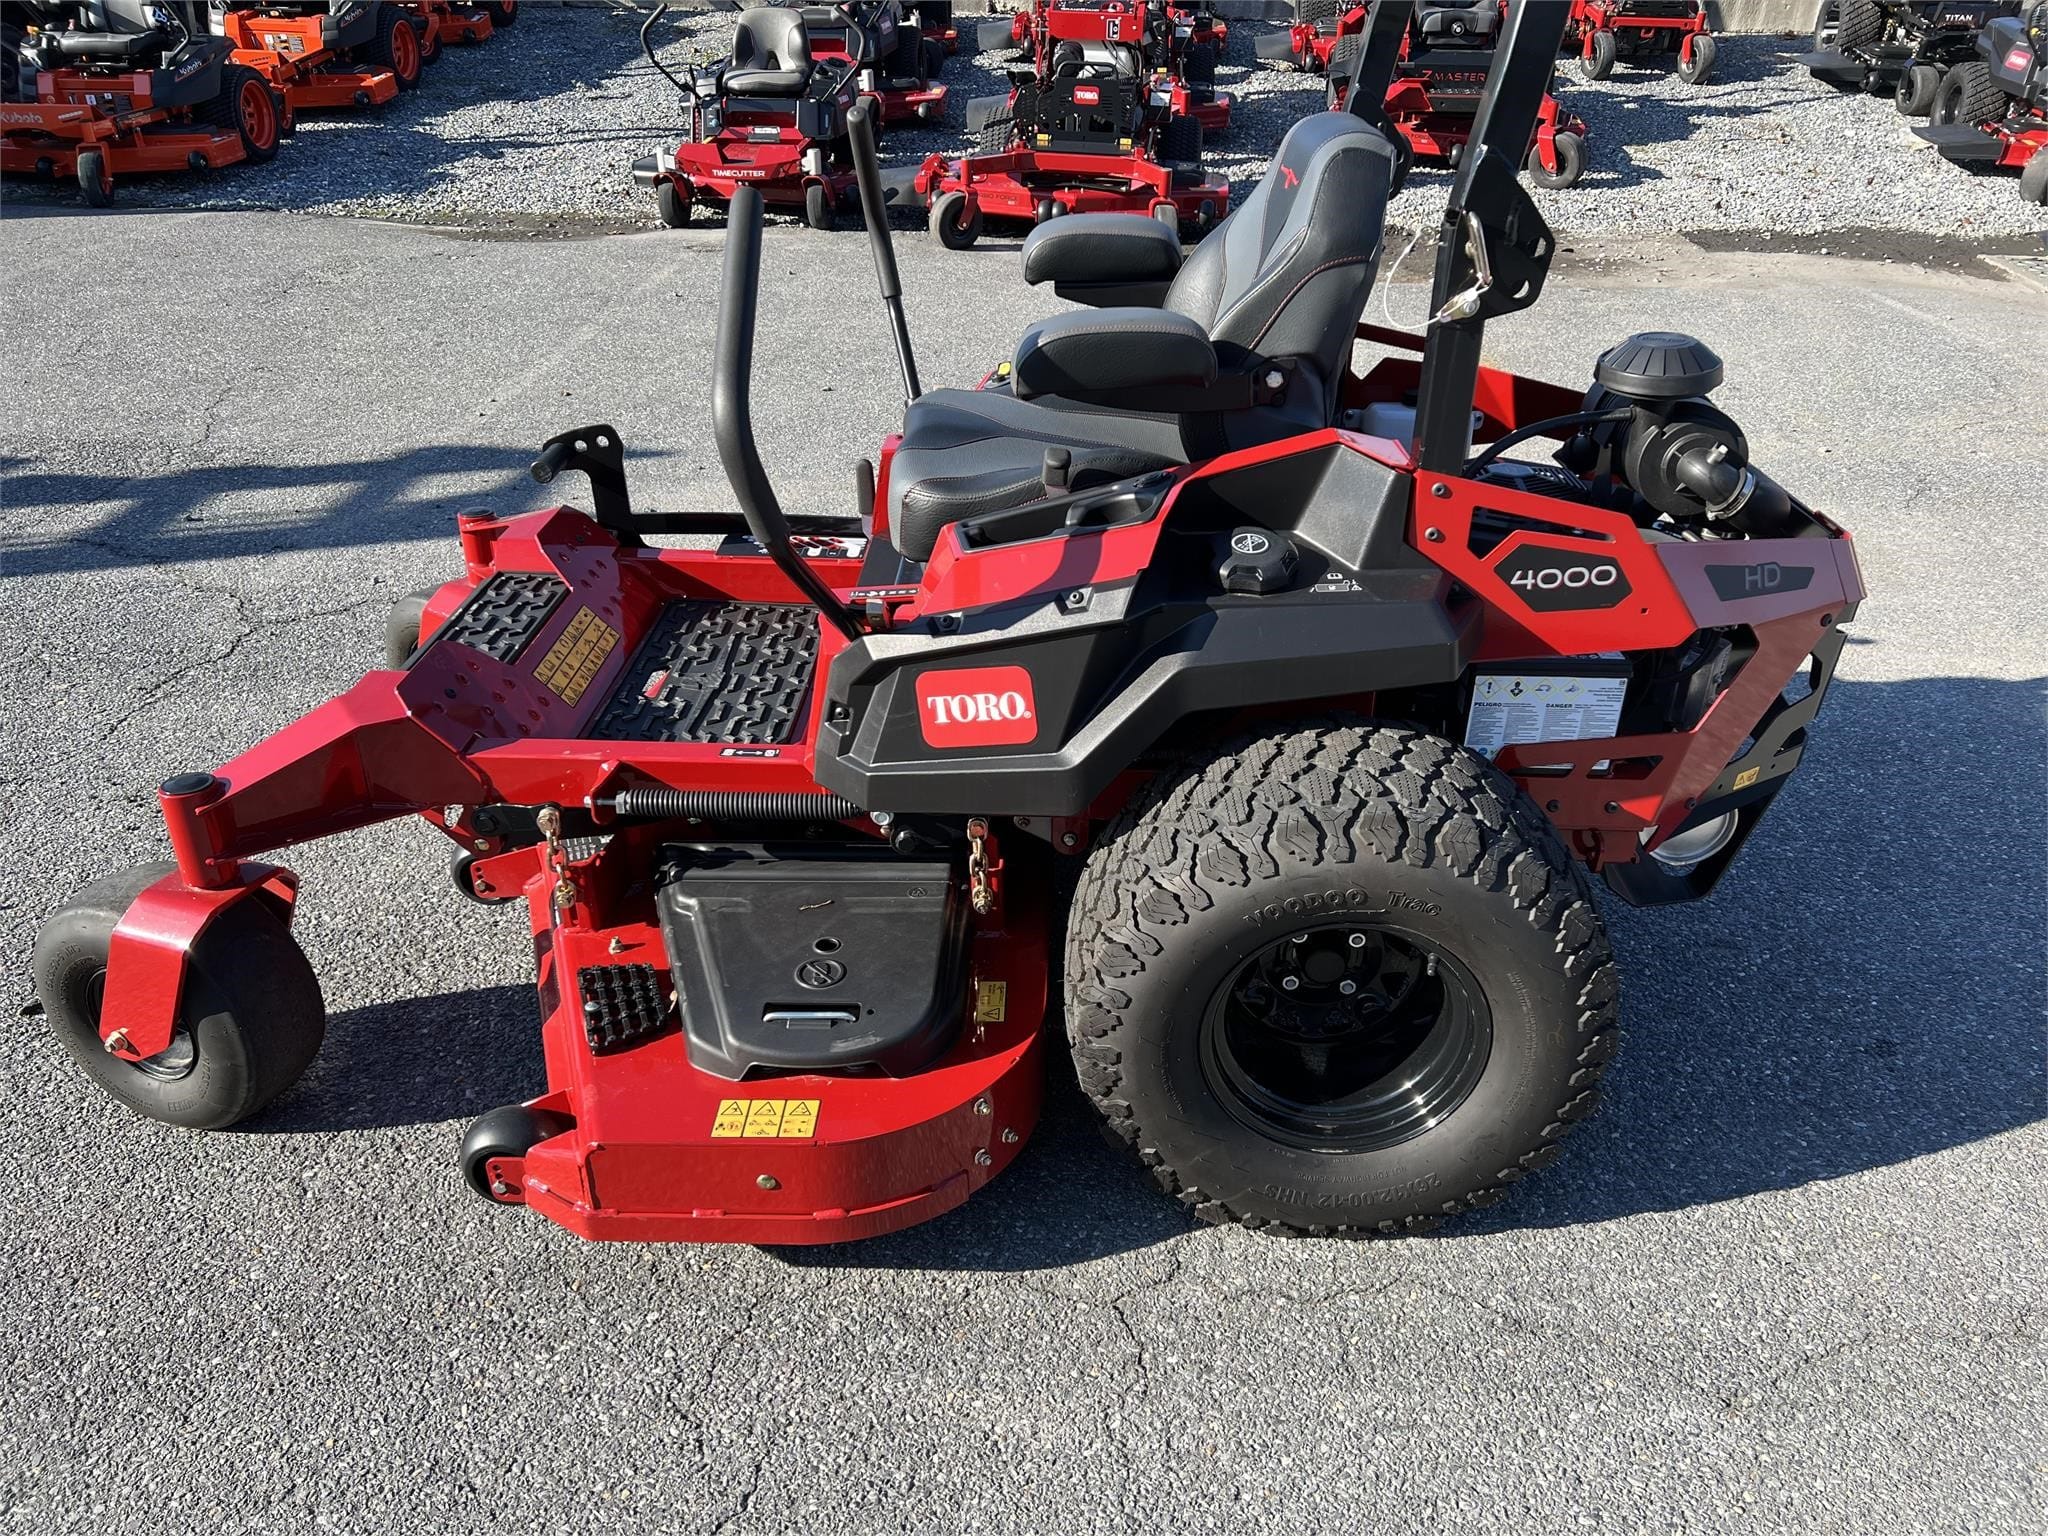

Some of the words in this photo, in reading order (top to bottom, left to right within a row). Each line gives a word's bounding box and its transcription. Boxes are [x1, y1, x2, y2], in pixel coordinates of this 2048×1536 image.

[1944, 14, 1974, 22] TITAN
[1421, 70, 1433, 80] Z
[1434, 72, 1486, 82] MASTER
[1075, 90, 1099, 100] TORO
[711, 169, 766, 178] TIMECUTTER
[1510, 565, 1617, 591] 4000
[1744, 563, 1782, 591] HD
[926, 691, 1026, 724] TORO
[1242, 888, 1368, 927] VOODOO
[1386, 889, 1443, 918] Trac
[1262, 1182, 1310, 1208] NHS
